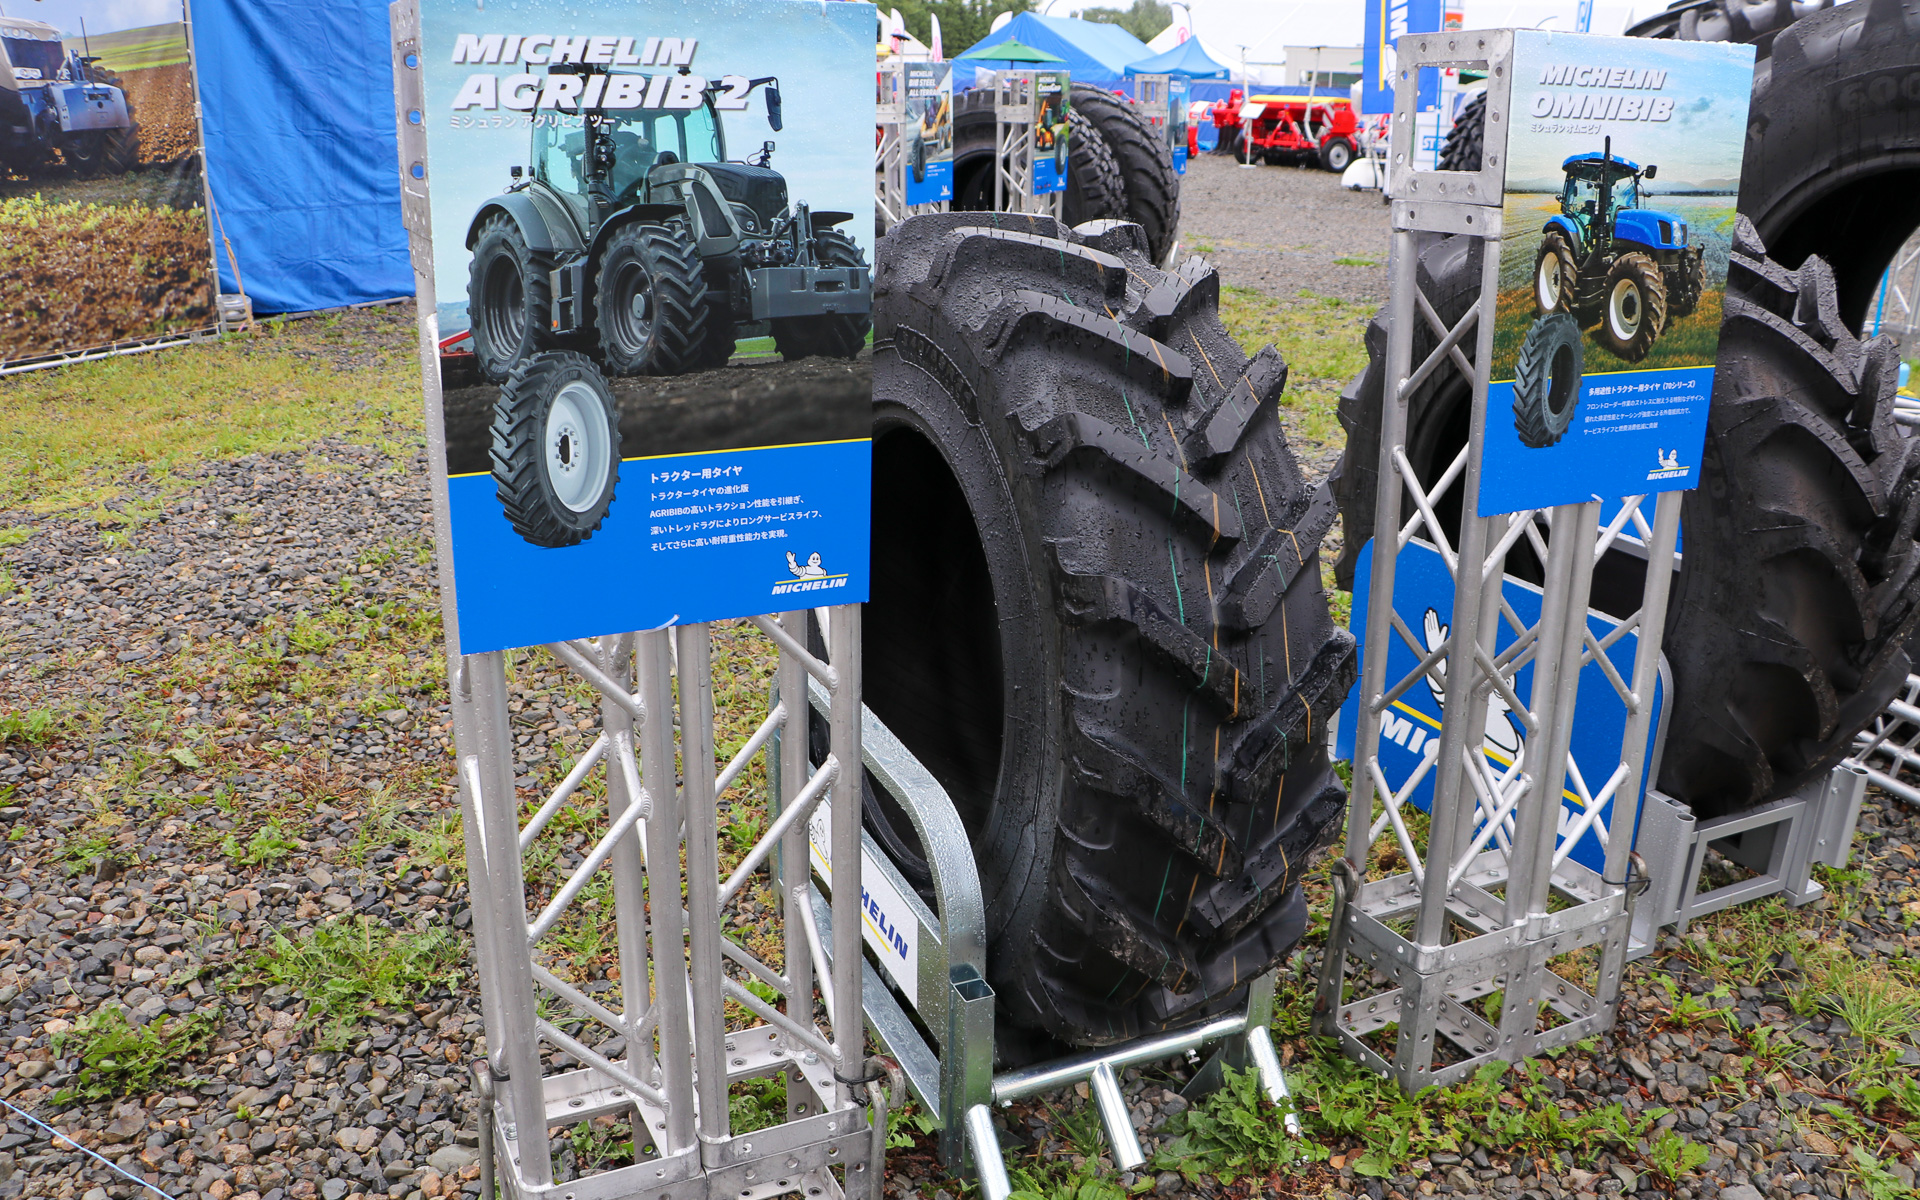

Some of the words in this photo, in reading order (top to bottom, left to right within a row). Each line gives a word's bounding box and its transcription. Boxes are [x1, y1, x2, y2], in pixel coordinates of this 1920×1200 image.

[451, 33, 698, 66] MICHELIN
[1539, 64, 1668, 90] MICHELIN
[450, 73, 709, 111] AGRIBIB
[713, 76, 751, 111] 2
[1530, 91, 1674, 122] OMNIBIB
[450, 115, 517, 129] ミシュラン
[520, 113, 587, 129] アグリビブ
[589, 115, 616, 128] ツー
[651, 465, 743, 484] トラクター用タイヤ
[1646, 469, 1689, 480] MICHELIN
[651, 484, 749, 502] トラクタータイヤの進化版
[649, 494, 805, 519] AGRIBIBの高いトラクション性能を引継ぎ、
[650, 509, 823, 536] 深いトレッドラグによりロングサービスライフ、
[650, 528, 789, 552] そしてさらに高い耐荷重性能力を実現。
[771, 577, 848, 596] MICHELIN
[861, 884, 908, 961] HELIN
